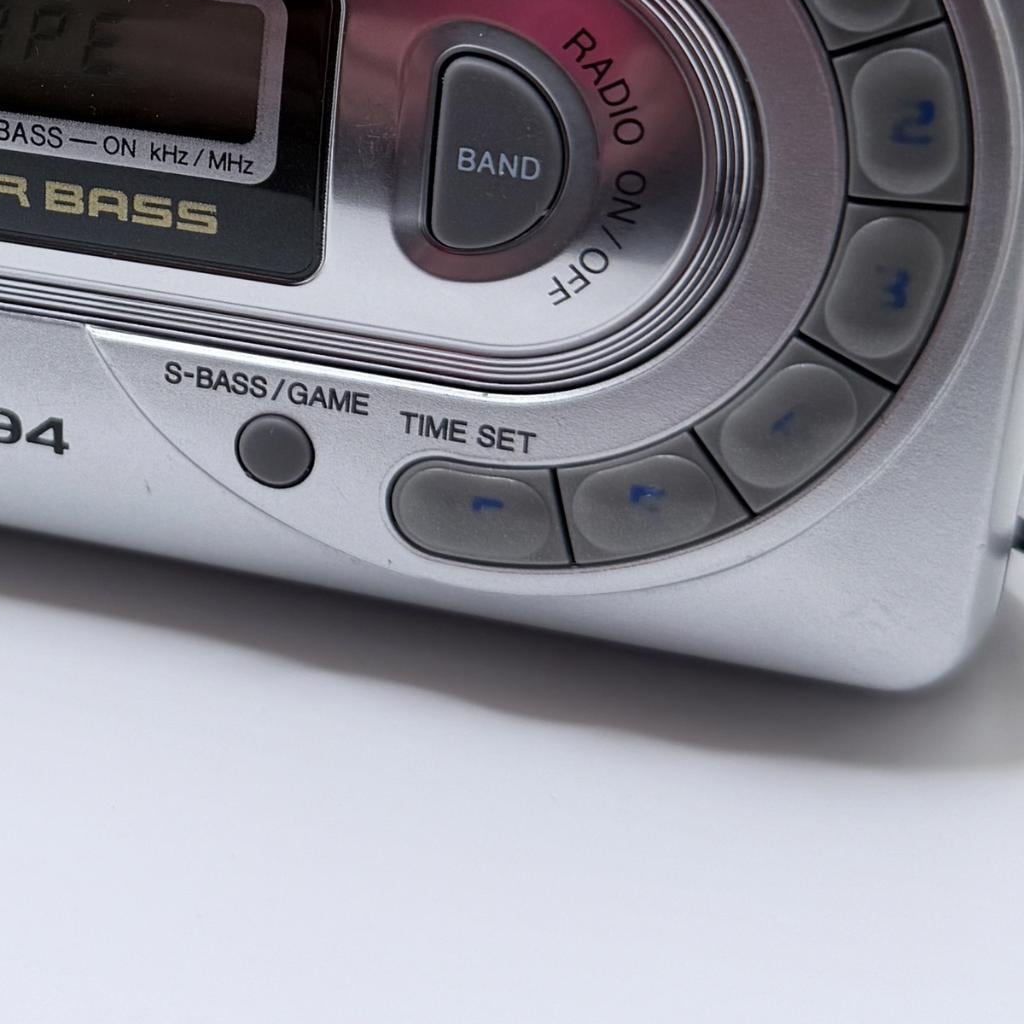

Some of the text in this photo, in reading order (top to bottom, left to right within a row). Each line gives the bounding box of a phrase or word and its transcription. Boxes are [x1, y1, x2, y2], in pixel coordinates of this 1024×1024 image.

[560, 26, 646, 147] RADIO
[102, 135, 138, 158] ON
[456, 146, 541, 181] BAND
[43, 184, 219, 235] BASS
[400, 411, 538, 456] TIME SET
